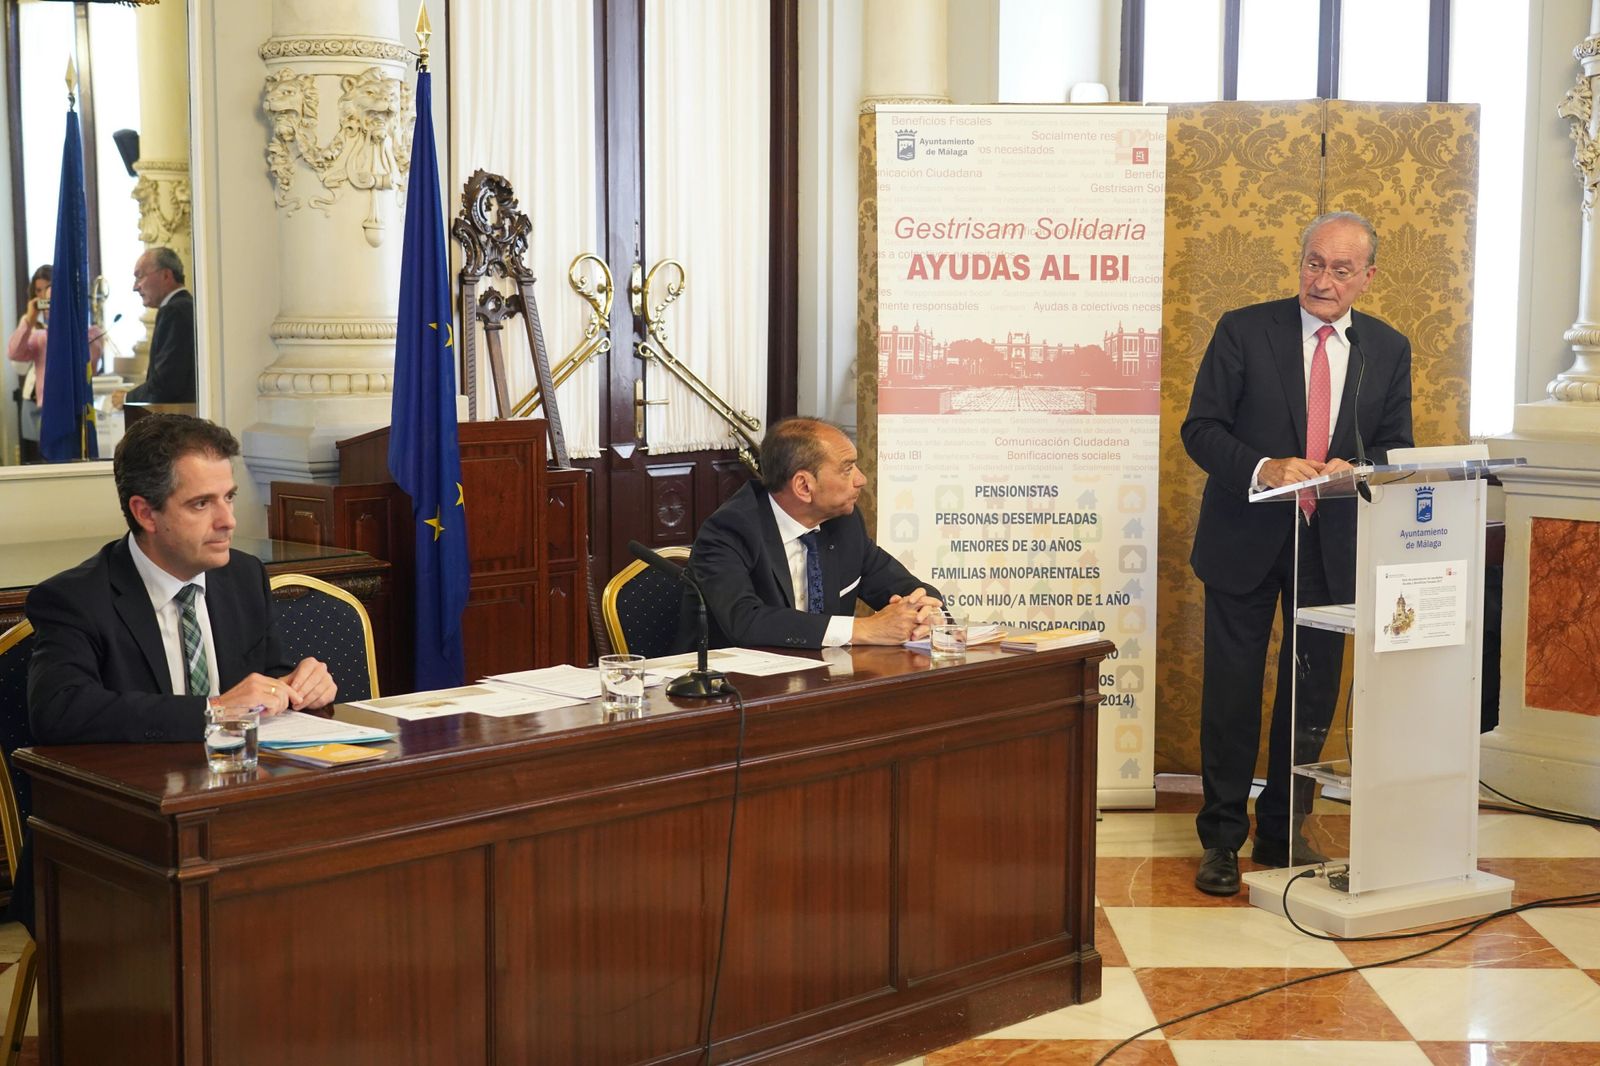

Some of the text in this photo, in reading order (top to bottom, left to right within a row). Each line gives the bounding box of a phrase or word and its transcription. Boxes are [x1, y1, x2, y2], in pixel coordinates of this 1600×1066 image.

[891, 115, 947, 126] Beneficios
[949, 115, 993, 126] Fiscales
[1031, 130, 1097, 142] Socialmente
[919, 137, 975, 150] Ayuntamiento
[925, 147, 968, 157] de Málaga
[925, 167, 983, 178] Ciudadana
[1090, 183, 1144, 193] Gestrisam
[894, 216, 1025, 240] Gestrisam
[1034, 216, 1147, 241] Solidaria
[906, 253, 1130, 282] AYUDAS AL IBI
[912, 300, 980, 312] responsables
[1033, 301, 1070, 313] Ayudas
[1071, 303, 1078, 312] a
[1080, 301, 1130, 312] colectivos
[994, 436, 1070, 447] Comunicación
[1073, 436, 1130, 447] Ciudadana
[908, 450, 922, 460] IBI
[1007, 450, 1079, 461] Bonificaciones
[1081, 450, 1121, 461] sociales
[975, 485, 1059, 498] PENSIONISTAS
[935, 512, 1098, 525] PERSONAS DESEMPLEADAS
[1399, 527, 1448, 541] Ayuntamiento
[950, 536, 1082, 552] MENORES DE 30 AÑOS
[1405, 538, 1442, 551] de Málaga
[931, 566, 1100, 580] FAMILIAS MONOPARENTALES
[958, 594, 983, 606] CON
[986, 593, 1026, 608] HIJO/A
[1029, 593, 1073, 606] MENOR
[1076, 594, 1093, 606] DE
[1095, 594, 1104, 606] 1
[1105, 590, 1131, 606] AÑO
[1019, 621, 1106, 633] DISCAPACIDAD
[1100, 693, 1135, 708] 2014)
